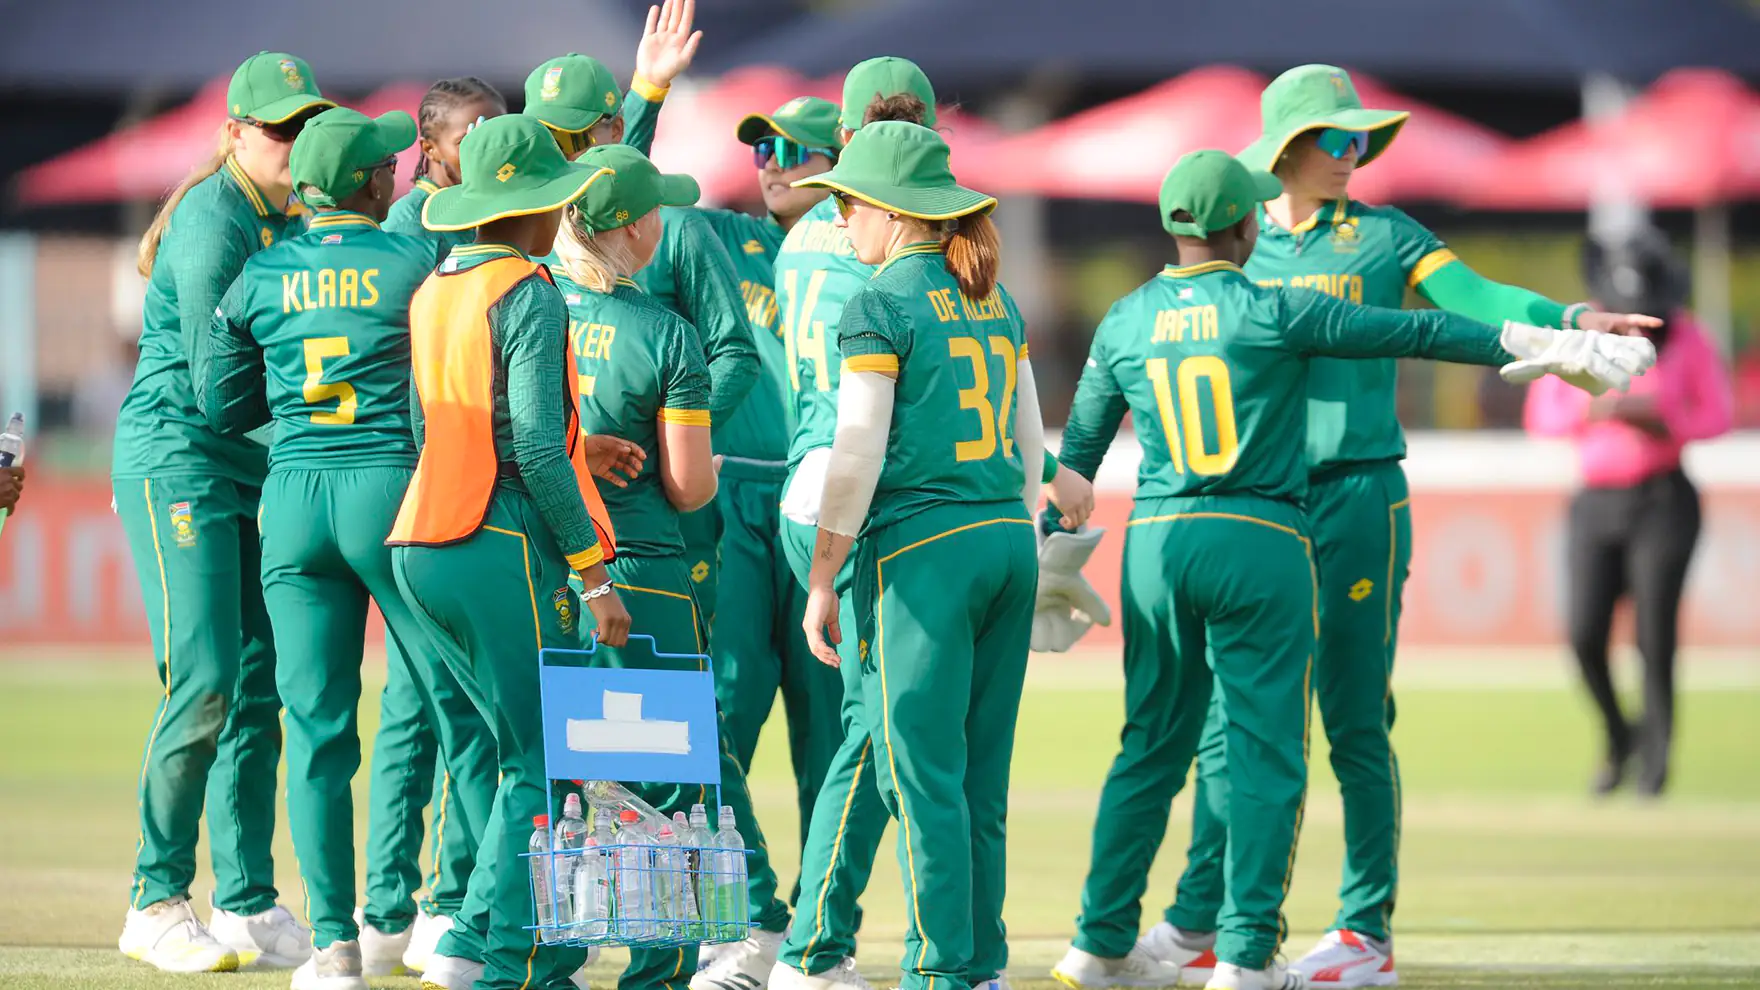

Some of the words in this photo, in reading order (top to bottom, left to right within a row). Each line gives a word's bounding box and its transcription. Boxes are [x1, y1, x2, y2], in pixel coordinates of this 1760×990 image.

[616, 210, 628, 222] 88
[282, 268, 380, 313] KLAAS
[927, 287, 960, 322] DE
[1150, 304, 1219, 344] JAFTA
[784, 269, 830, 392] 14
[302, 336, 358, 425] 5
[948, 335, 1018, 462] 32
[1146, 355, 1239, 476] 10
